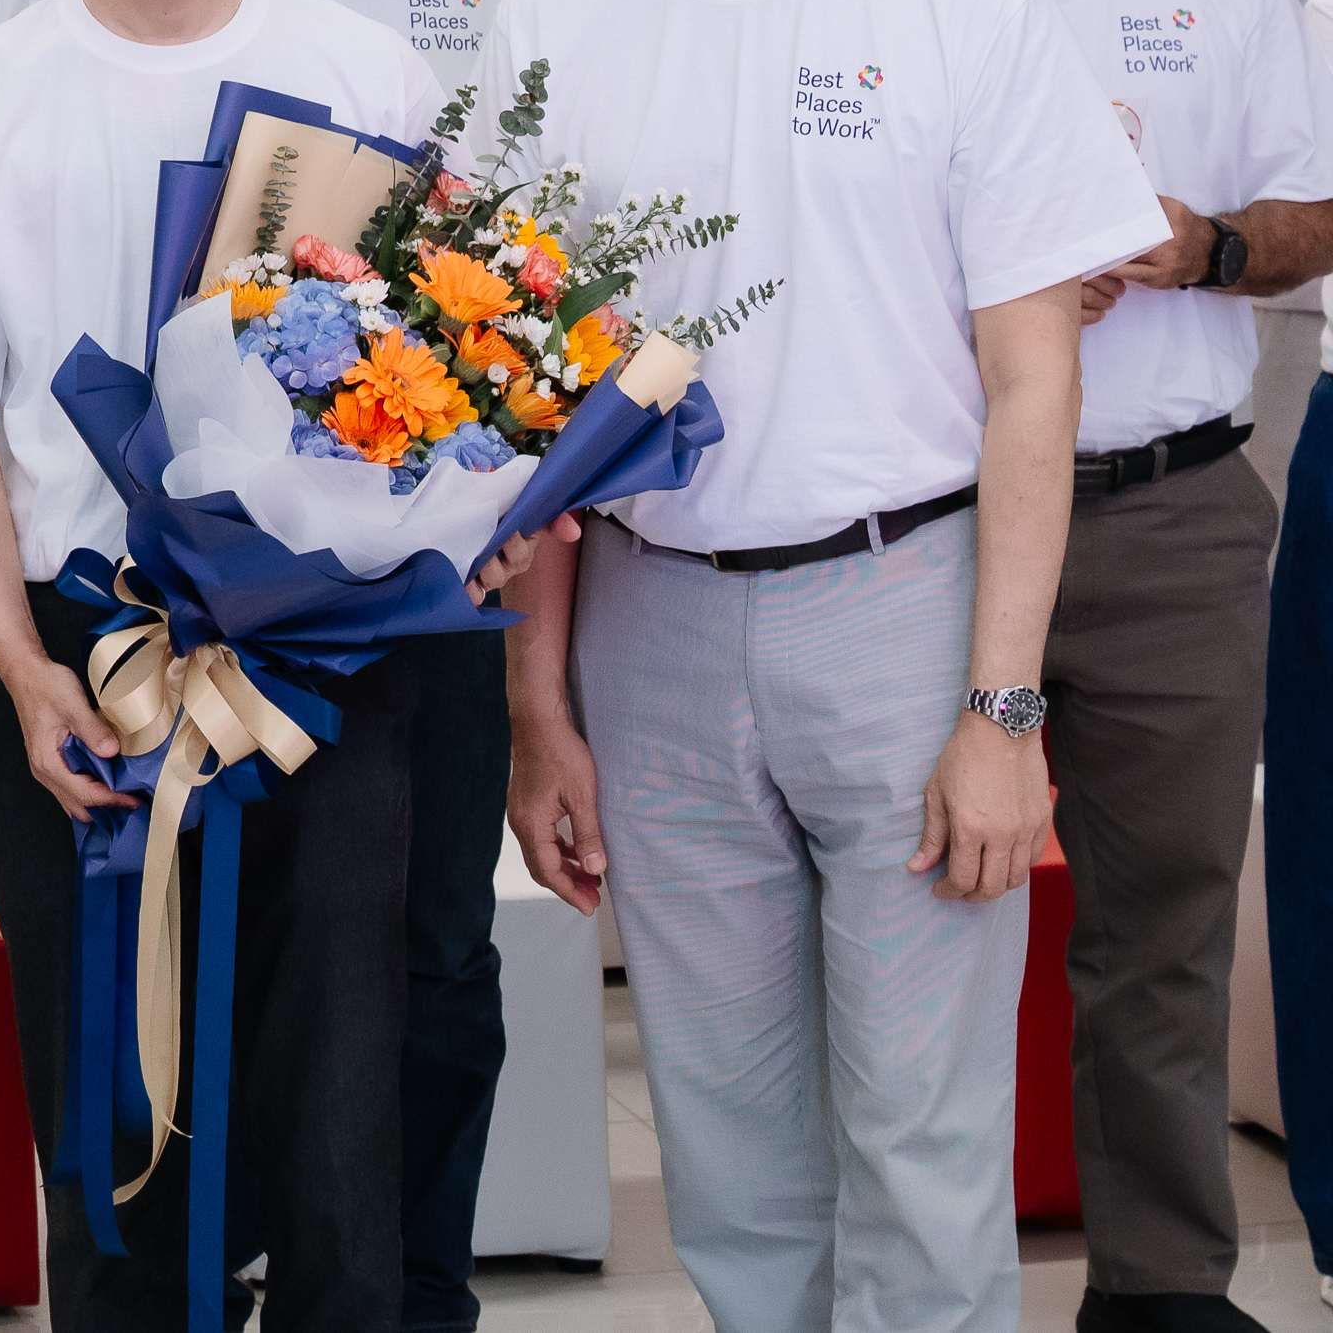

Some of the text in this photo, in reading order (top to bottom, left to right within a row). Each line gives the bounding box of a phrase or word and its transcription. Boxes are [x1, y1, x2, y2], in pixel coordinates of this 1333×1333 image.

[411, 12, 469, 29] Places
[1119, 16, 1163, 32] Best
[411, 34, 431, 50] to
[1123, 36, 1183, 53] Places
[1124, 57, 1145, 74] to
[797, 67, 844, 89] Best
[795, 91, 862, 115] Places
[792, 116, 811, 136] to
